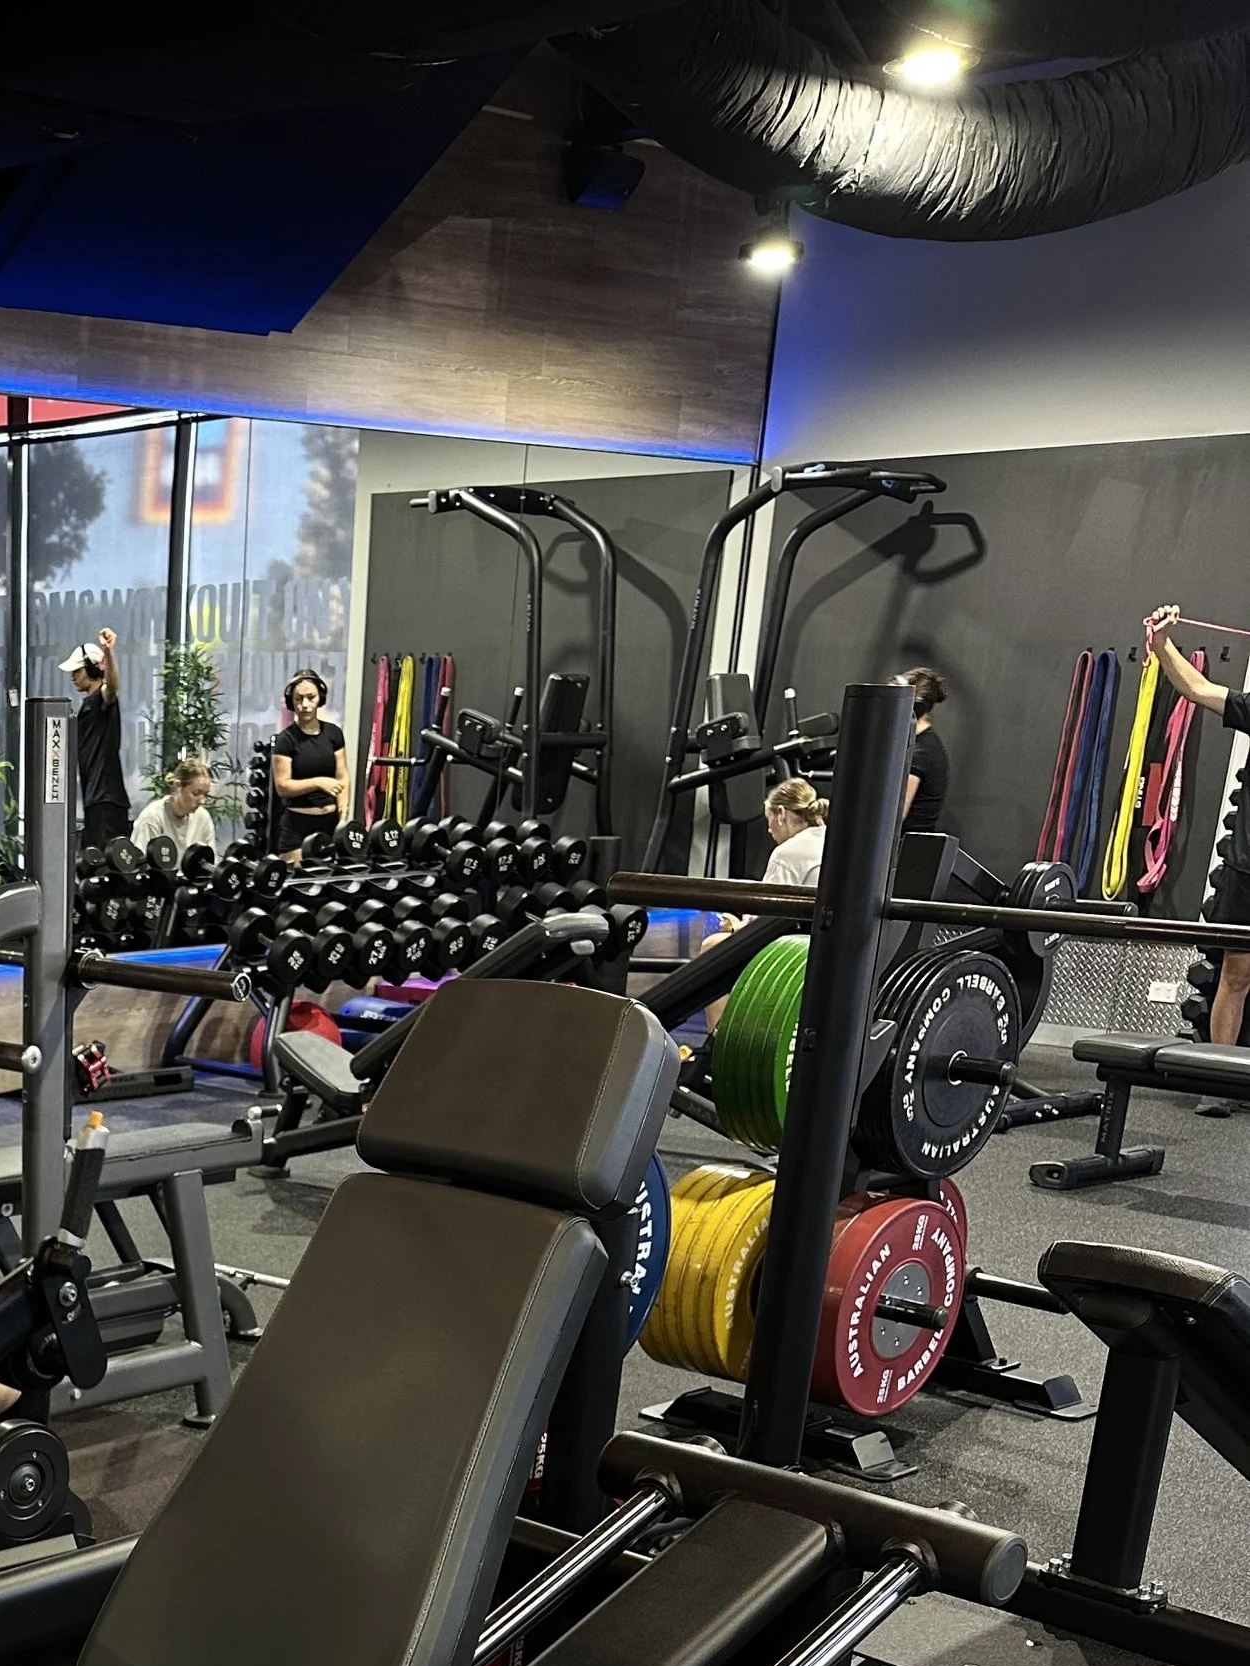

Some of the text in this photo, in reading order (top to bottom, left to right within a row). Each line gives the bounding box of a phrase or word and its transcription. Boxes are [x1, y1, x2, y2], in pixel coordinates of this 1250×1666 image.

[904, 973, 1006, 1085] BARBELL COMPANY
[911, 1214, 927, 1251] 25KG
[930, 1226, 957, 1308] COMPANY
[847, 1243, 892, 1378] AUSTRALIAN
[876, 1368, 891, 1404] 25KG
[534, 1432, 548, 1479] 25KG
